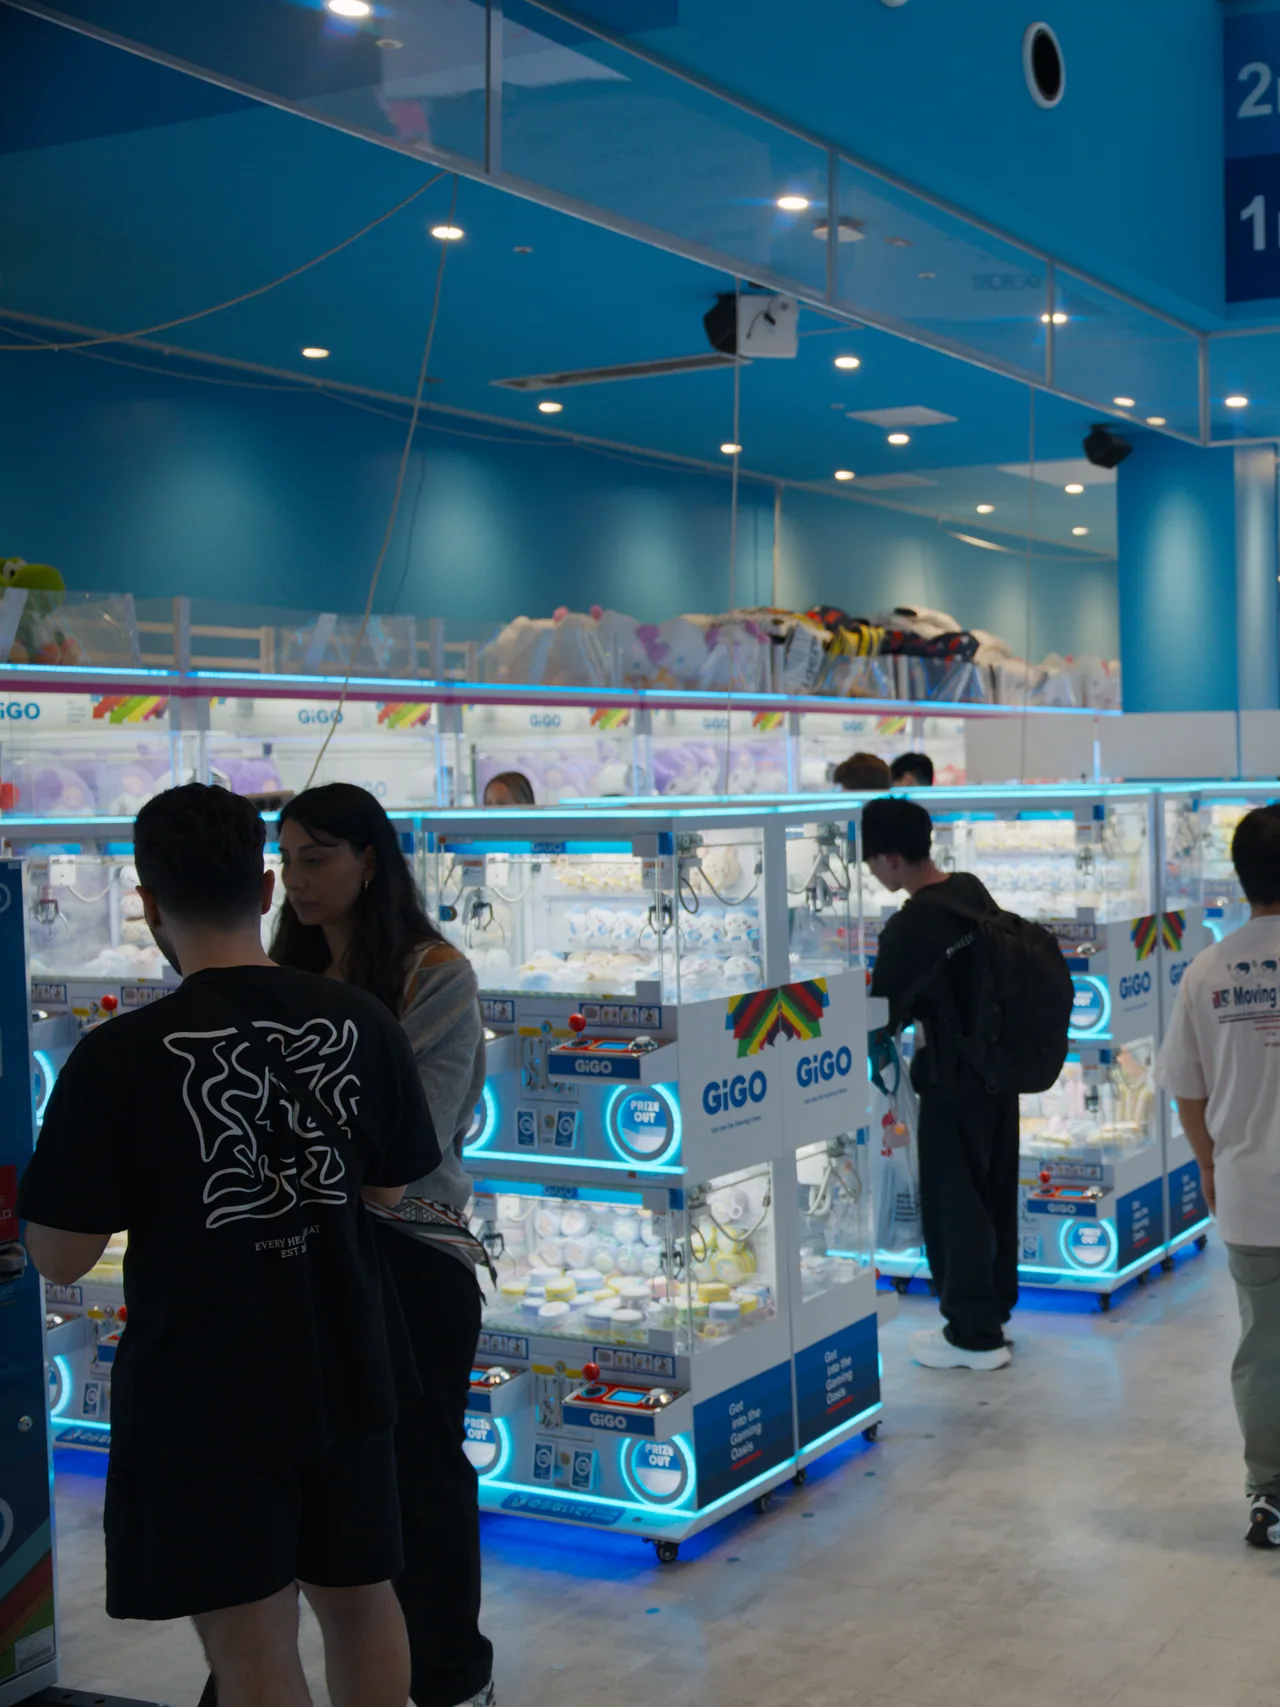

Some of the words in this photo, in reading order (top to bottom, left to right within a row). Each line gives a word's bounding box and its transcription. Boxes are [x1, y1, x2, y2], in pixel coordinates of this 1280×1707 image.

[0, 701, 40, 720] iGO
[298, 709, 343, 724] GiGO
[1119, 971, 1152, 1000] GiGO
[1233, 984, 1277, 1008] Moving
[575, 1059, 613, 1074] GiGO
[795, 1045, 853, 1088] GiGO
[702, 1070, 767, 1116] GiGO
[630, 1099, 660, 1113] PRIZE
[634, 1111, 656, 1124] OUT
[255, 1239, 286, 1252] EVERY
[281, 1248, 299, 1259] EST
[729, 1400, 744, 1416] Get
[589, 1413, 627, 1429] GiGO
[732, 1416, 748, 1430] into
[748, 1408, 761, 1421] the
[467, 1429, 488, 1440] OUT
[730, 1423, 762, 1446] Gaming
[645, 1443, 674, 1456] PRIZE
[731, 1441, 754, 1461] Oasis
[649, 1455, 671, 1467] OUT
